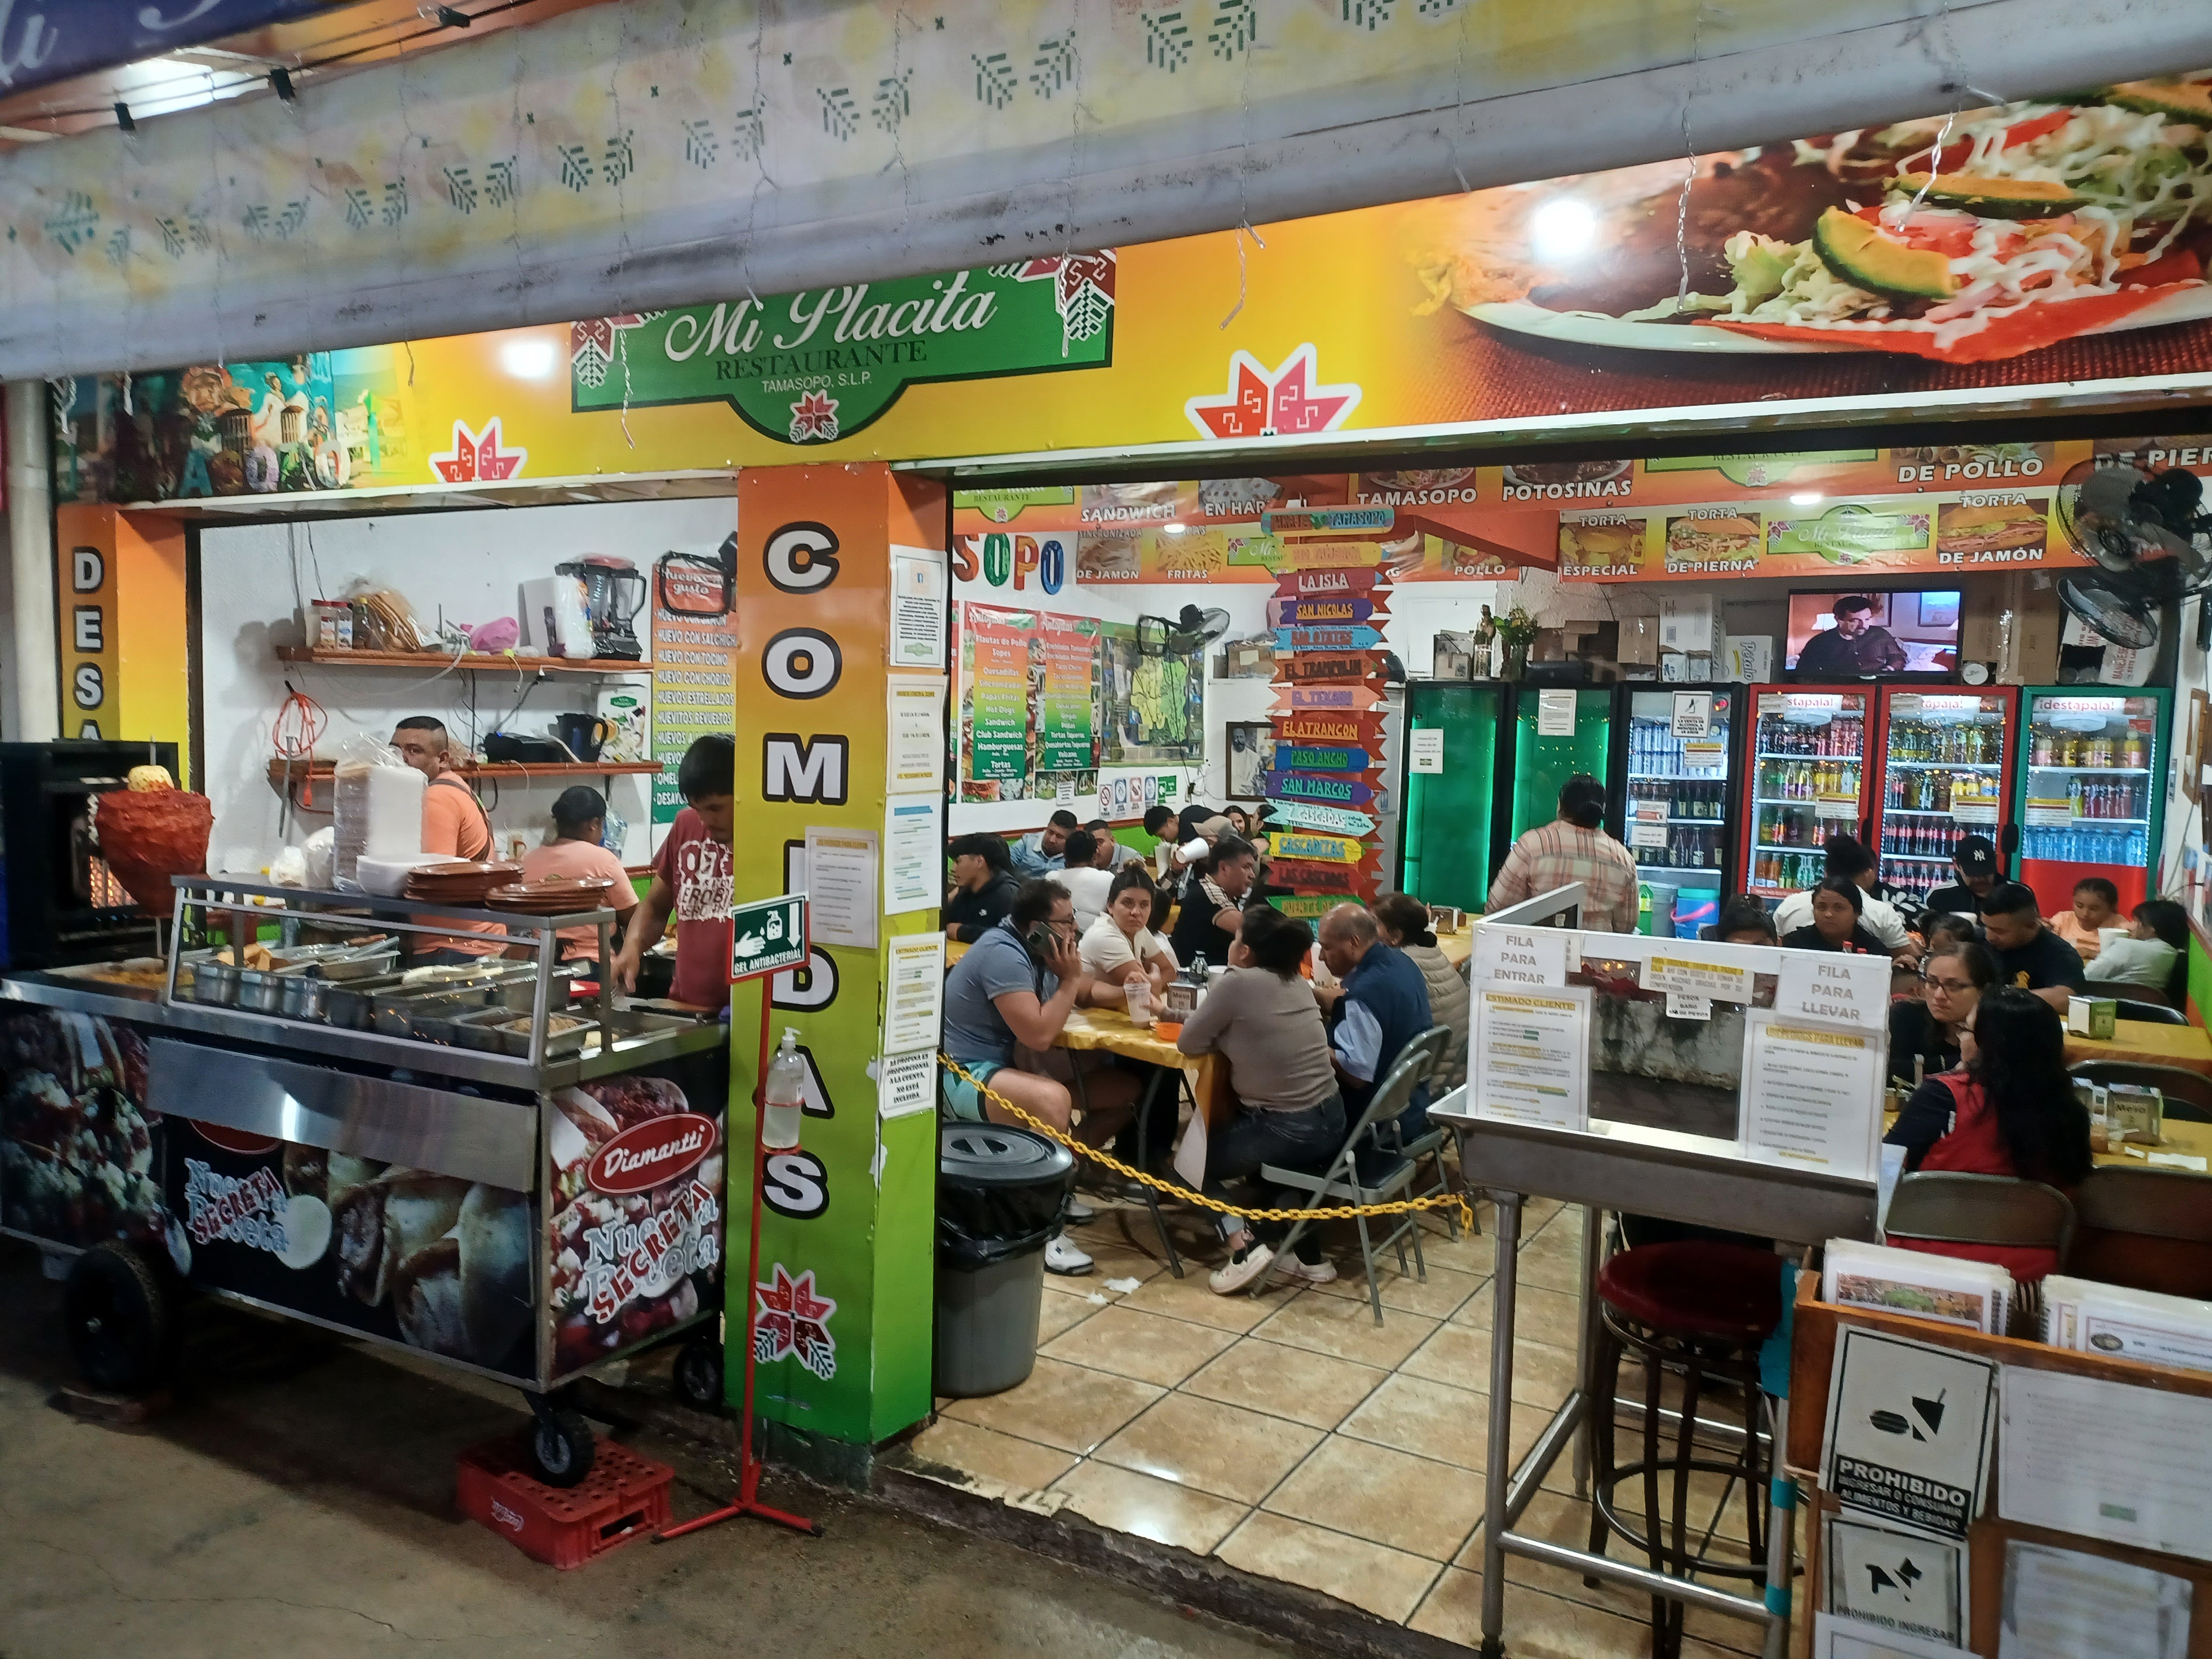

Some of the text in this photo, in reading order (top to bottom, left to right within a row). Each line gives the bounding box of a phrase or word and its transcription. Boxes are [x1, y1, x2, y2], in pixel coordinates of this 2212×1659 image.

[665, 271, 998, 362] Mi Placita
[717, 340, 927, 380] RESTAURANTE
[838, 372, 872, 385] S.L.P.
[1898, 457, 2043, 482] DE POLLO
[1357, 488, 1477, 506] TAMASOPO
[1503, 480, 1631, 500] POTOSINAS
[1205, 500, 1265, 517] EN HAR
[1960, 494, 2027, 507] TORTA
[1081, 504, 1176, 523] SANDWICH
[1329, 511, 1384, 529] TAMASOPO
[1579, 515, 1627, 526] TORTA
[1688, 508, 1738, 520] TORTA
[1939, 547, 2043, 564] DE JAMÓN
[1167, 570, 1208, 579] FRITAS
[1454, 565, 1506, 576] POLLO
[1562, 564, 1637, 576] ESPECIAL
[1667, 560, 1755, 573] DE PIERNA
[1077, 570, 1092, 580] DE
[1299, 572, 1349, 592] LA ISLA
[673, 583, 709, 595] gusto
[1296, 603, 1354, 619] SAN NICOLAS
[658, 629, 683, 643] HUEVO
[684, 630, 701, 644] CON
[976, 635, 1000, 645] Flautas
[1001, 638, 1009, 646] de
[658, 649, 728, 666] HUEVO CON TOCINO
[658, 670, 732, 686] HUEVO CON CHORIZO
[983, 666, 1019, 676] Quesadillas
[657, 690, 734, 706] HUEVOS ESTRELLADOS
[1787, 697, 1833, 708] stapala!
[1921, 697, 1963, 709] tapala!
[657, 711, 732, 725] HUEVITOS REVUELTOS
[985, 718, 1015, 727] Sandwich
[657, 731, 686, 745] HUEVOS
[993, 731, 1022, 739] Sandwich
[1283, 721, 1358, 740] EL ATRANCON
[978, 743, 1023, 752] Hamburguesas
[1291, 751, 1348, 768] PASO ANCHO
[657, 773, 679, 785] OMEL
[1281, 778, 1353, 800] SAN MARCOS
[1298, 808, 1347, 829] CASCADAS
[1279, 837, 1346, 858] CASCADITAS
[1281, 899, 1318, 917] PUENTE
[1506, 935, 1533, 948] FILA
[735, 947, 802, 975] GEL ANTIBACTERIAL
[1501, 952, 1536, 966] PARA
[1494, 969, 1545, 984] ENTRAR
[1818, 964, 1851, 980] FILA
[1486, 994, 1531, 1005] ESTIMADO
[1811, 983, 1854, 1000] PARA
[1802, 1001, 1860, 1020] LLEVAR
[603, 1125, 706, 1178] Diamantti
[1839, 1459, 1965, 1506] PROHIBIDO
